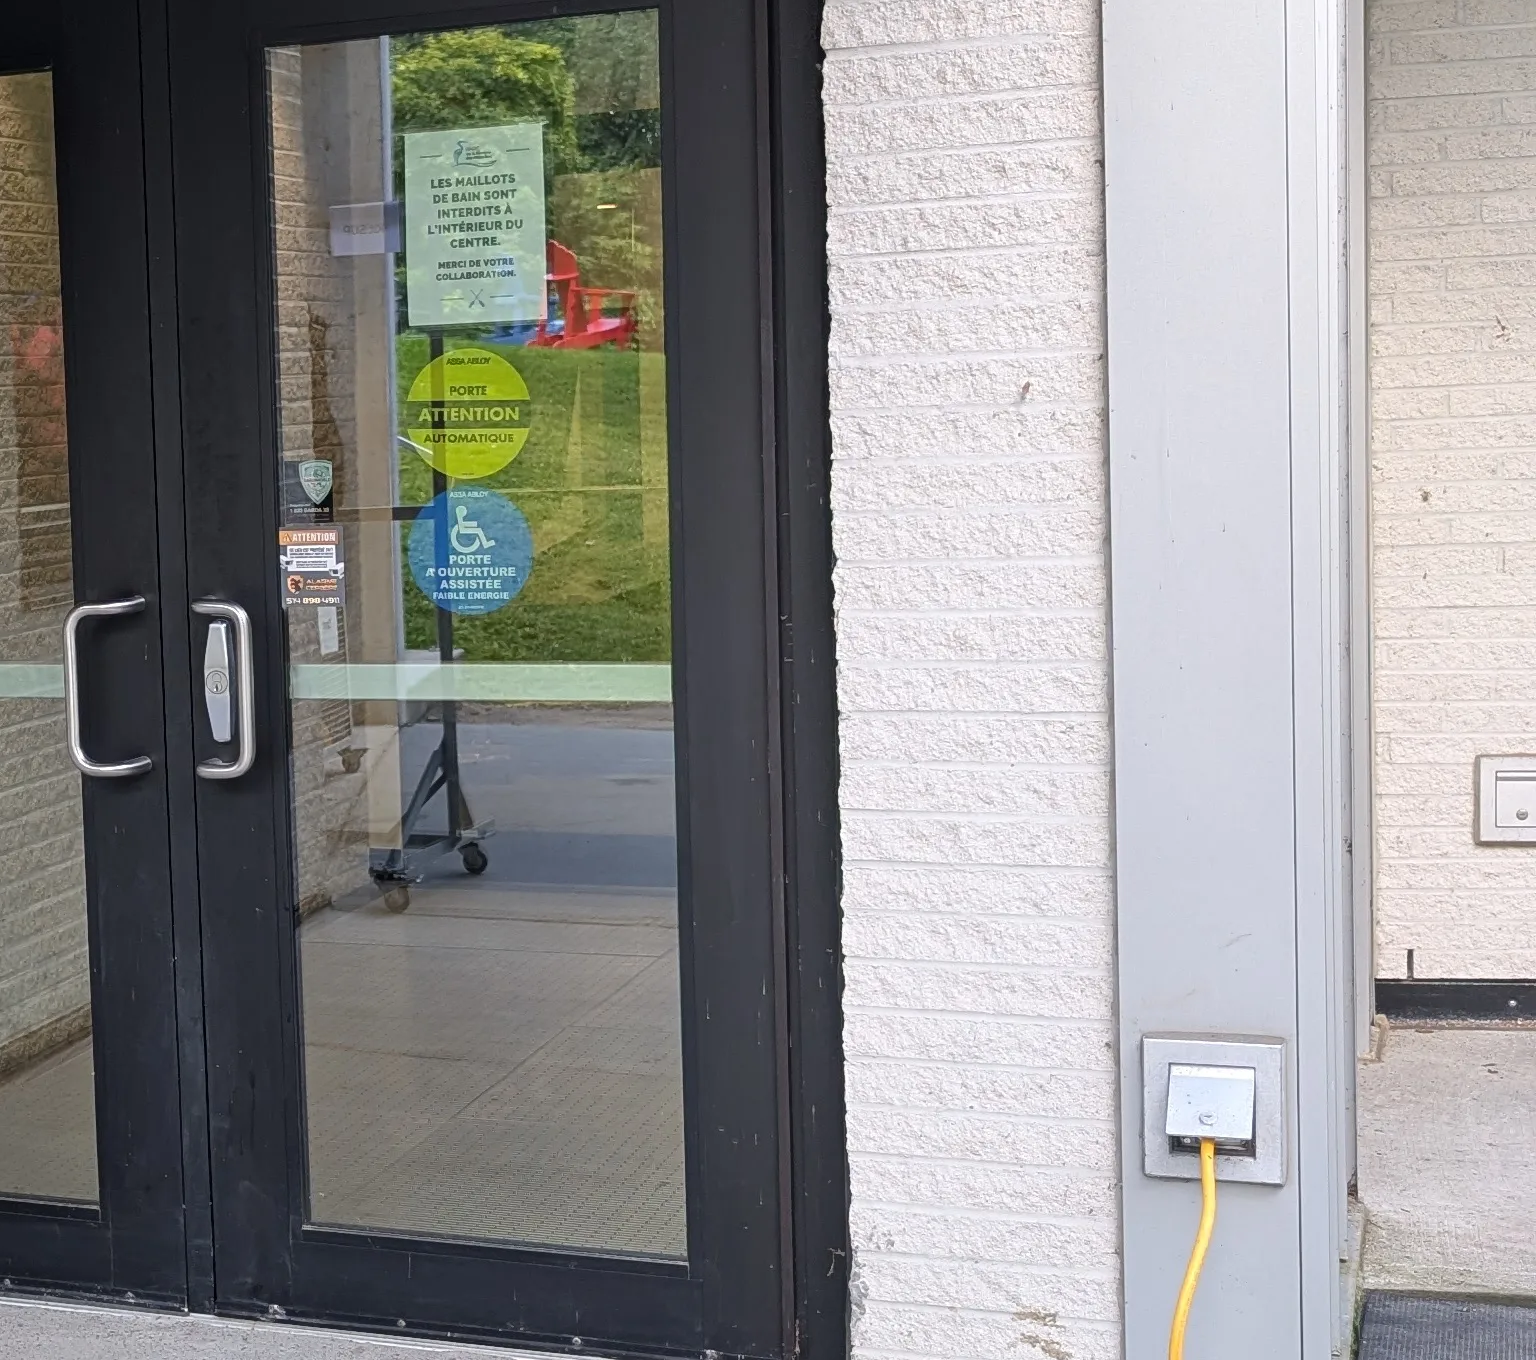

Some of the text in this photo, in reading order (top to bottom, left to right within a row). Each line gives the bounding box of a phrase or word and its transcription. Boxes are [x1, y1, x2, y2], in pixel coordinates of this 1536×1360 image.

[430, 174, 516, 189] LES MAILLOTS
[432, 189, 517, 204] DE BAIN SONT
[437, 202, 513, 219] INTERDITS À
[427, 219, 524, 235] L'INTÉRIEUR DU
[450, 237, 501, 249] CENTRE.
[437, 257, 514, 269] MERCI DE VOTRE
[435, 270, 517, 281] COLLABORATION.
[449, 385, 487, 396] PORTE
[419, 406, 520, 422] ATTENTION
[423, 433, 514, 444] AUTOMATIQUE
[292, 532, 336, 542] ATTENTION
[449, 554, 492, 565] PORTE
[438, 566, 517, 577] OUVERTURE
[440, 577, 502, 589] ASSISTÉE
[285, 597, 301, 605] 514
[433, 591, 466, 600] FAIBLE
